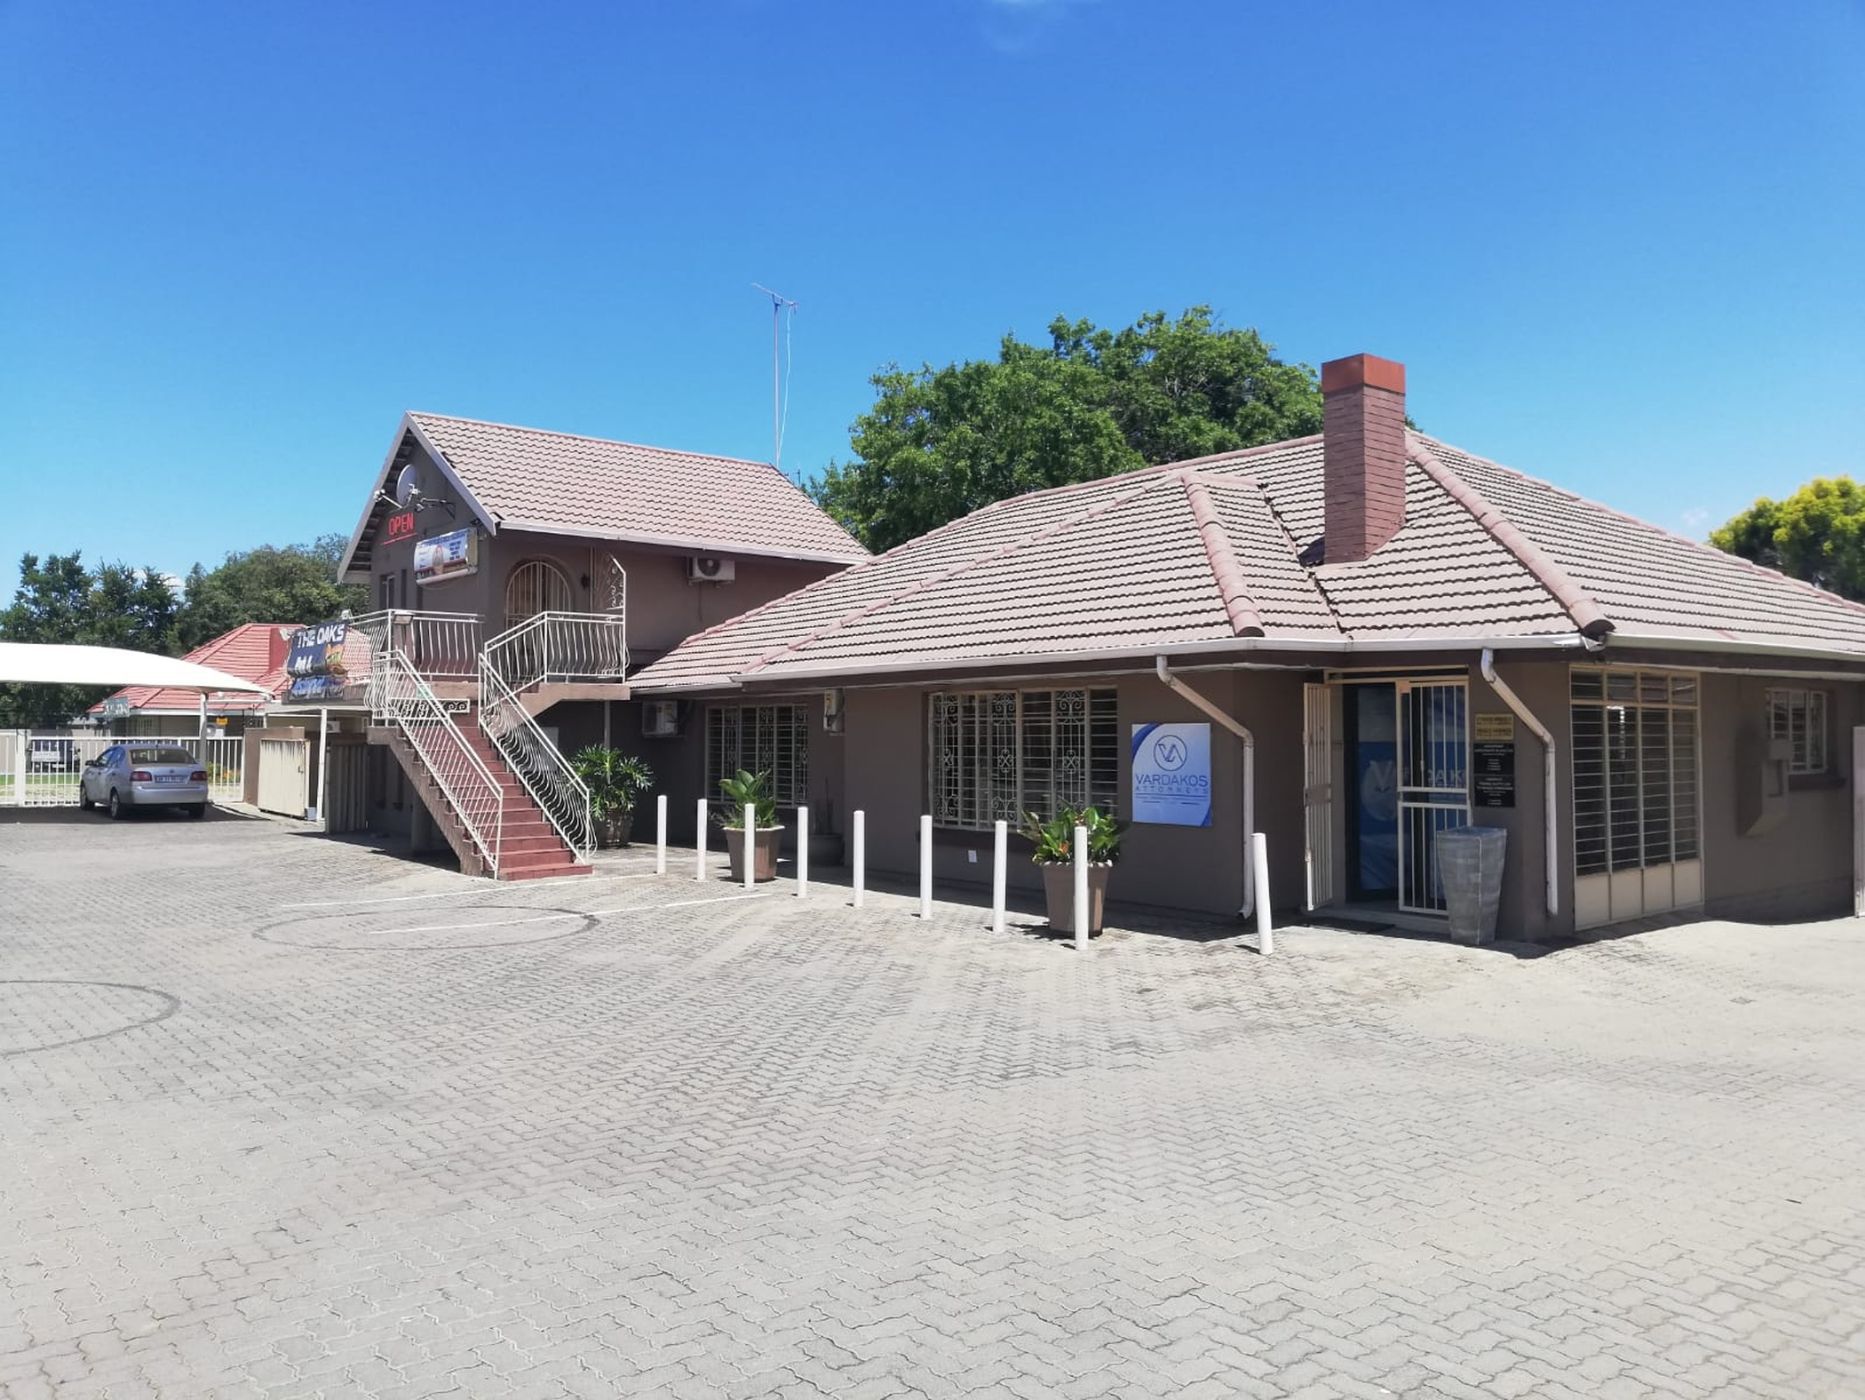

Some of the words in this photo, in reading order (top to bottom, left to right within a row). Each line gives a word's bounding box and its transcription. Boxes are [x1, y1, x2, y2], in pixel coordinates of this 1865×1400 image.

[389, 512, 414, 536] OPEN
[297, 629, 316, 649] THE
[316, 623, 345, 645] OAKS
[1135, 774, 1208, 788] VARDAKOS
